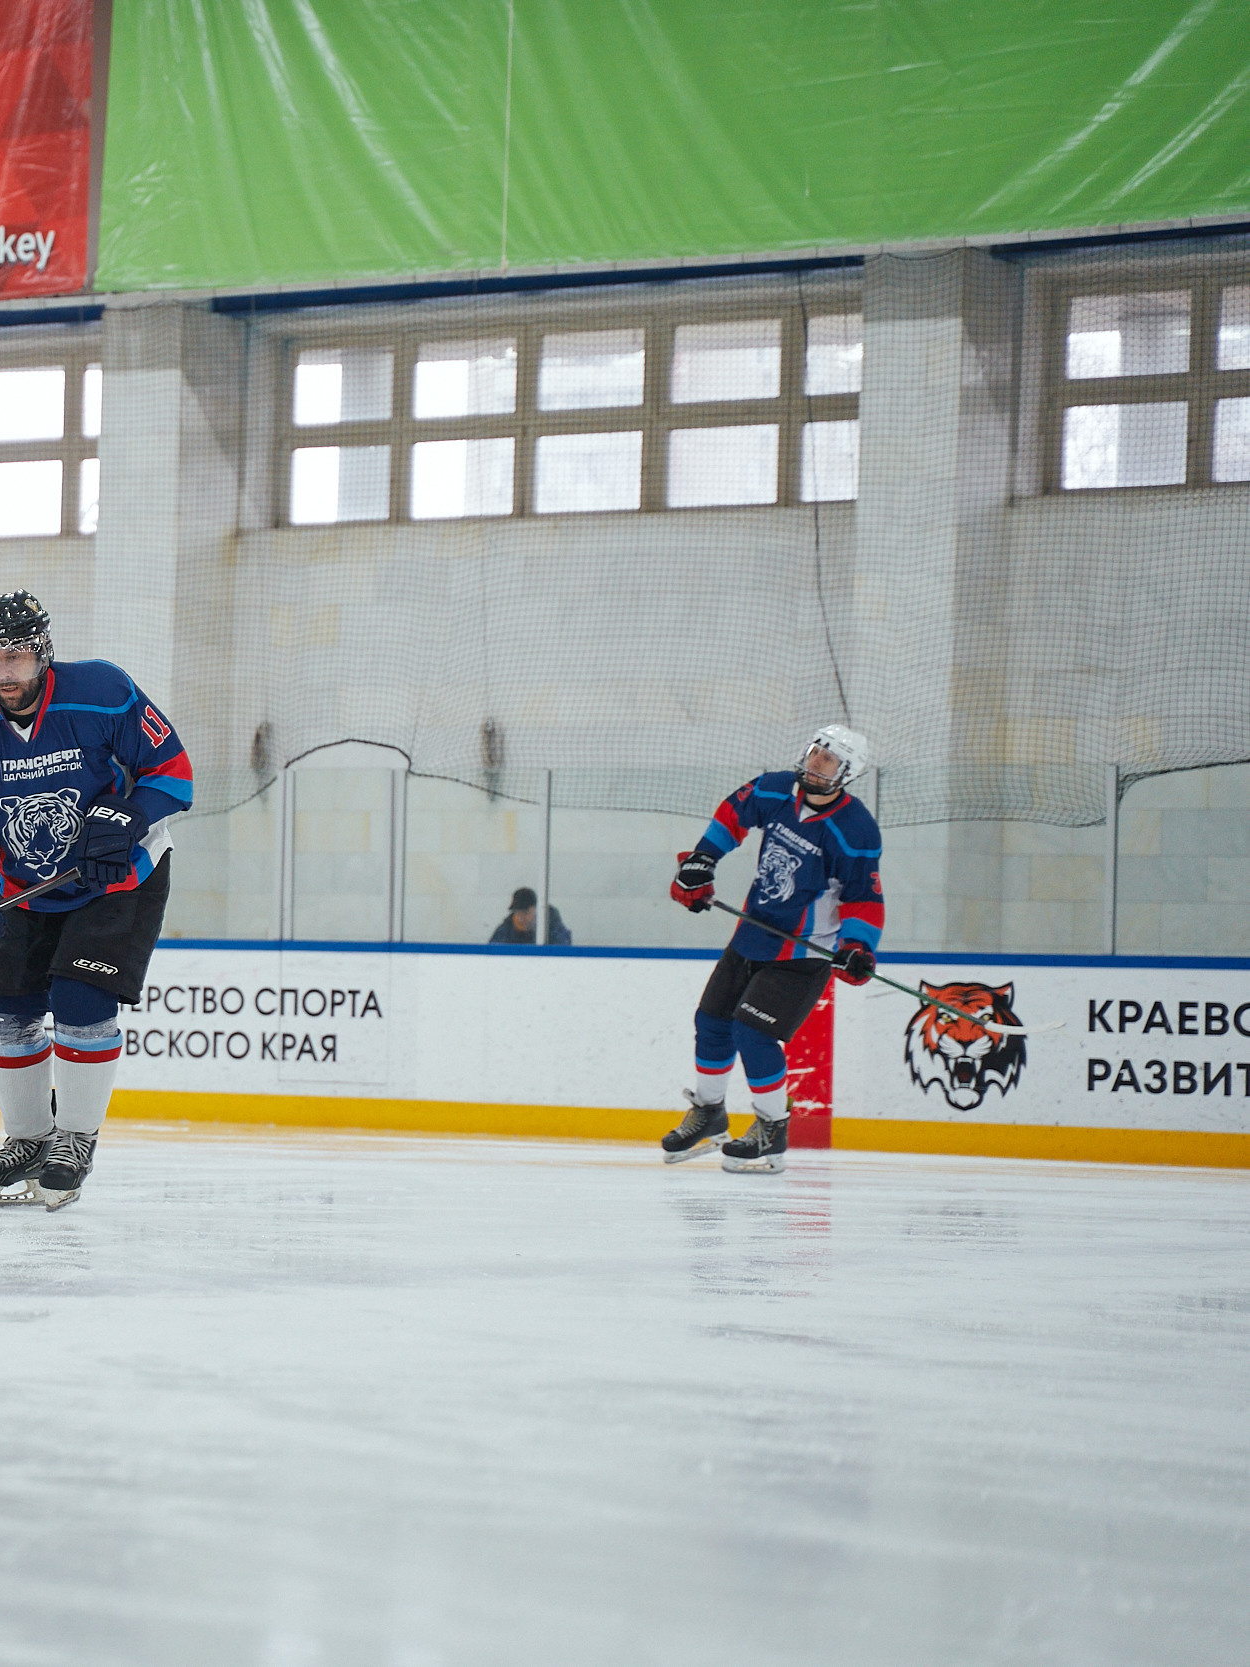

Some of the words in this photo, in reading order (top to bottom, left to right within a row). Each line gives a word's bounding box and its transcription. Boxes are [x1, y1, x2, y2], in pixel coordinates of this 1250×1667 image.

[140, 704, 172, 749] 11
[3, 767, 46, 782] ДАЛЬНИЙ
[46, 761, 83, 776] ВОСТОК
[77, 958, 114, 975] CCM
[119, 985, 245, 1015] РСТВО
[254, 988, 384, 1018] СПОРТА
[124, 1029, 250, 1060] ВСКОГО
[261, 1032, 338, 1063] КРАЯ
